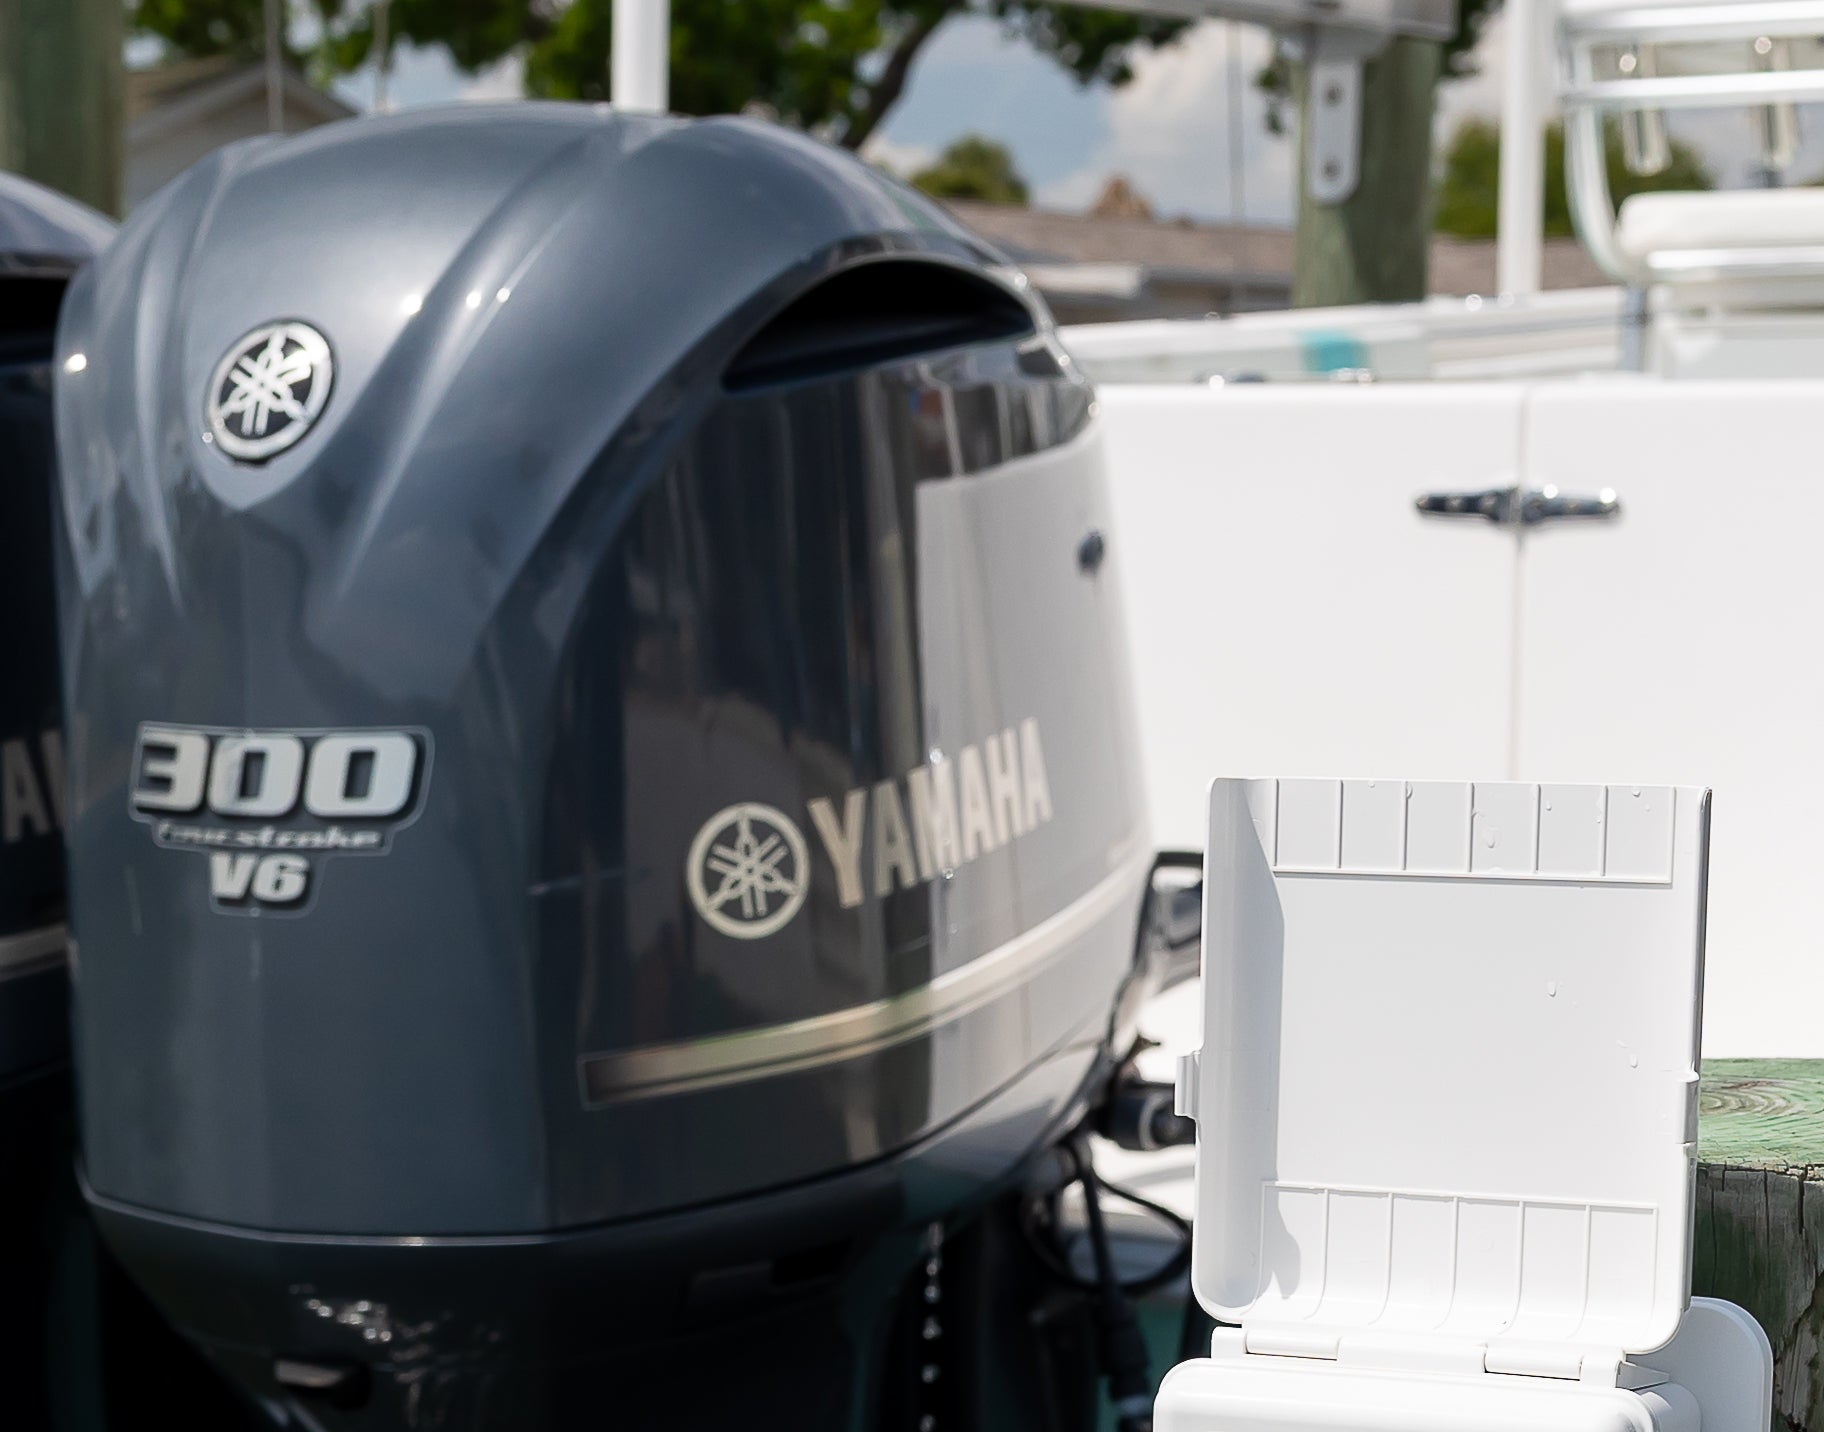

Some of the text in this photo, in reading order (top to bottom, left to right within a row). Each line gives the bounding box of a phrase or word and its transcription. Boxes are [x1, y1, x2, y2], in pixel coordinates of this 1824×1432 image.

[133, 731, 417, 817] 300
[807, 716, 1053, 908] YAMAHA
[210, 852, 311, 902] V6
